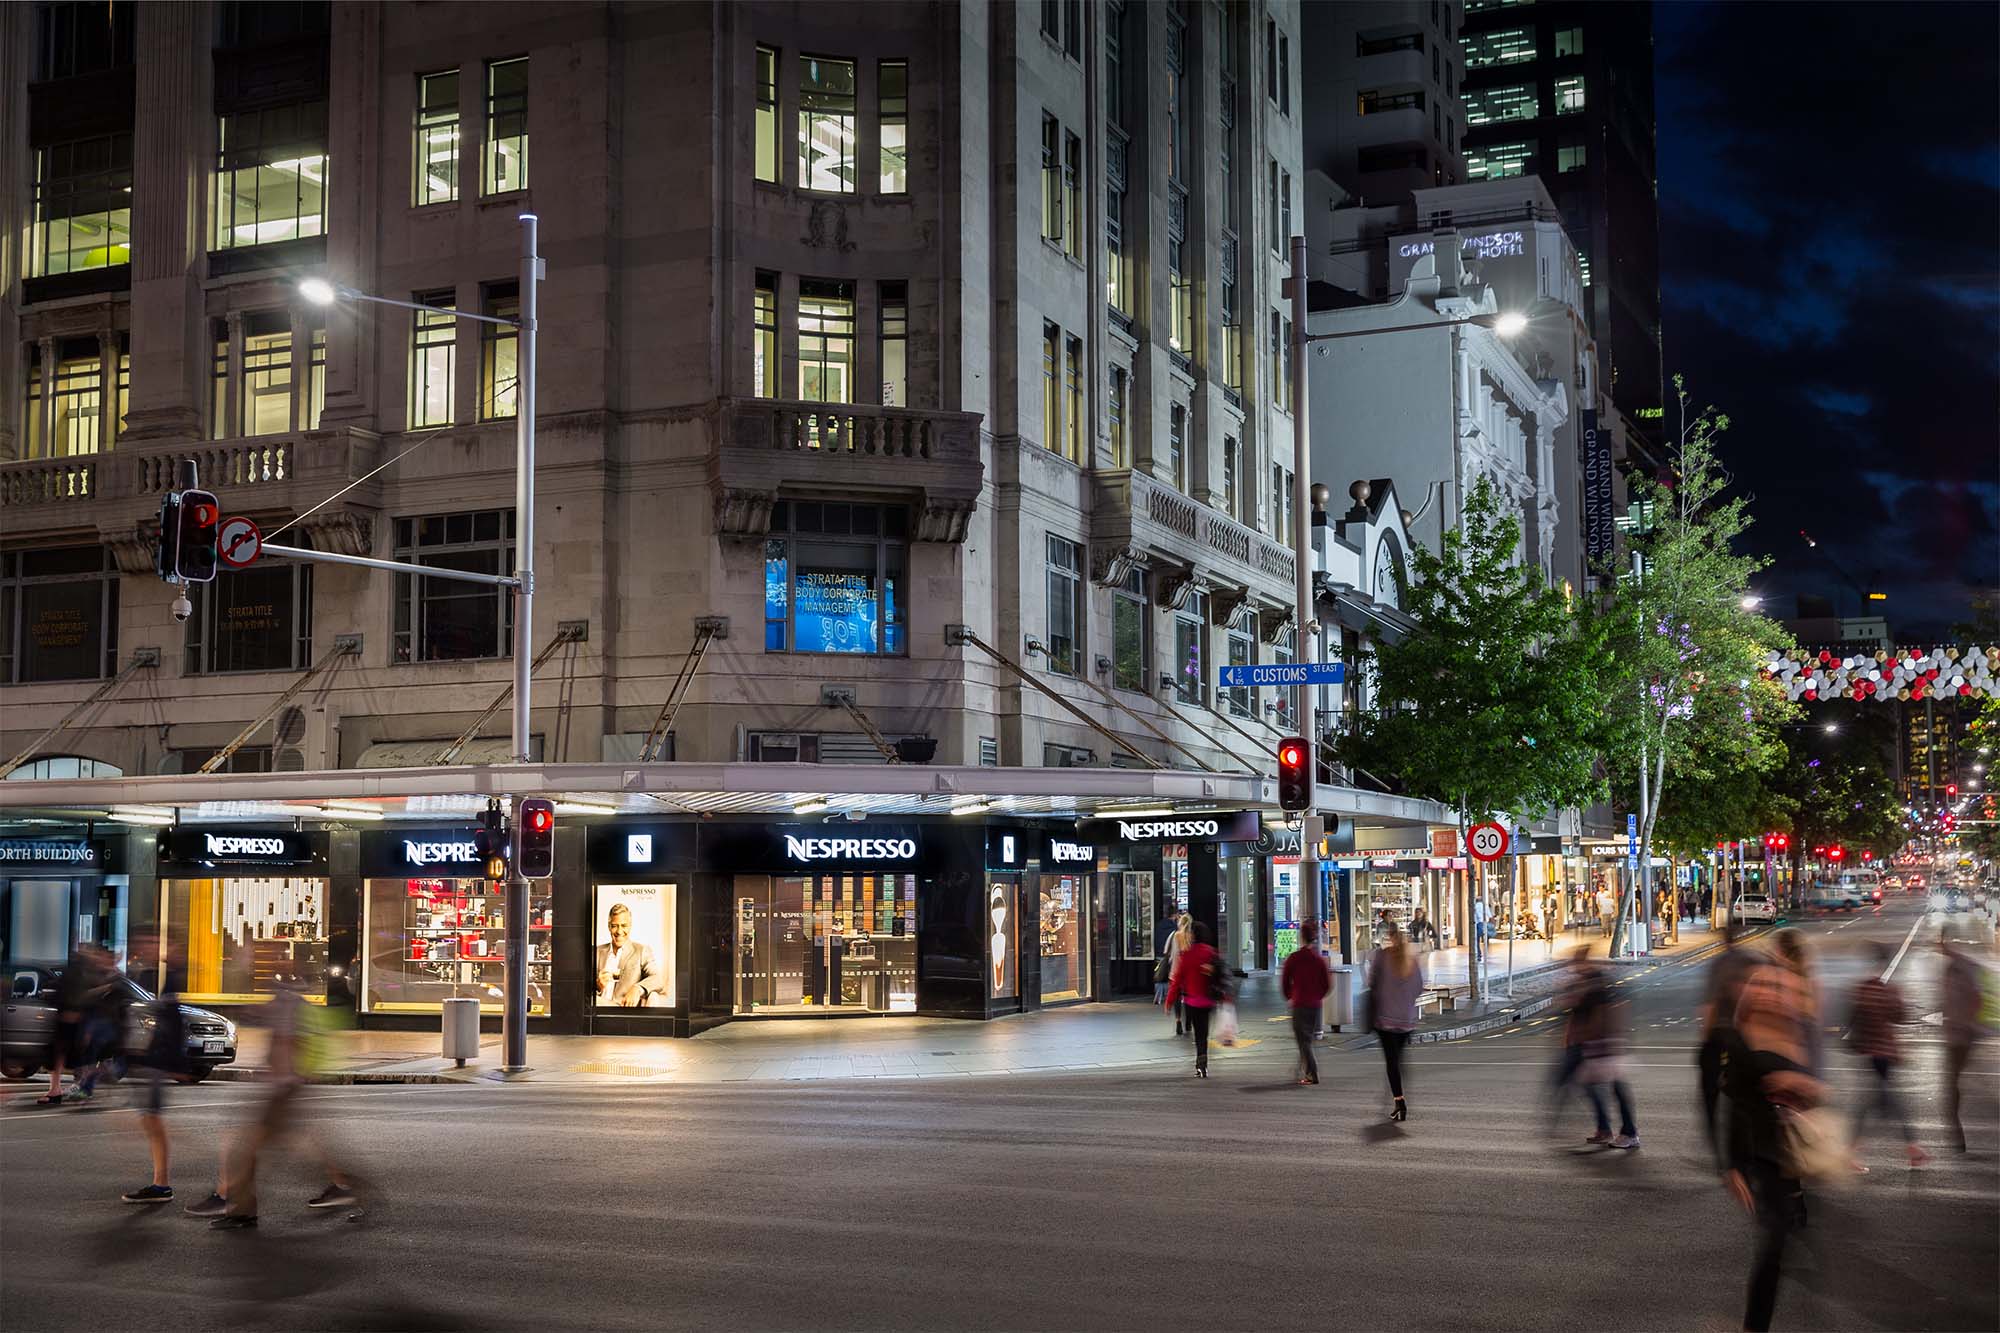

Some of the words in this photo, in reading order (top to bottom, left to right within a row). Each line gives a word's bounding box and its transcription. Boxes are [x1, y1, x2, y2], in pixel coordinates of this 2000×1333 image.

[1400, 242, 1435, 257] GRA
[1479, 244, 1524, 258] HOTEL
[1584, 429, 1598, 481] GRAND
[1599, 449, 1611, 499] GRAND
[1600, 502, 1614, 570] WINDS
[807, 573, 840, 585] STRATA
[842, 575, 867, 587] TITLE
[795, 588, 821, 599] BODY
[823, 588, 878, 600] CORPORATE
[1253, 667, 1308, 683] CUSTOMS
[1312, 665, 1321, 673] ST
[1321, 664, 1338, 672] EAST
[1118, 820, 1219, 841] NESPRESSO
[204, 833, 285, 857] NESPRESSO
[784, 834, 917, 863] NESPRESSO
[1277, 840, 1300, 852] JA
[1476, 833, 1499, 849] 30
[34, 848, 94, 861] BUILDING
[403, 840, 482, 866] NESPRE
[1592, 846, 1616, 856] LOUIS
[489, 859, 504, 877] 10
[621, 887, 657, 895] NESPRESSO
